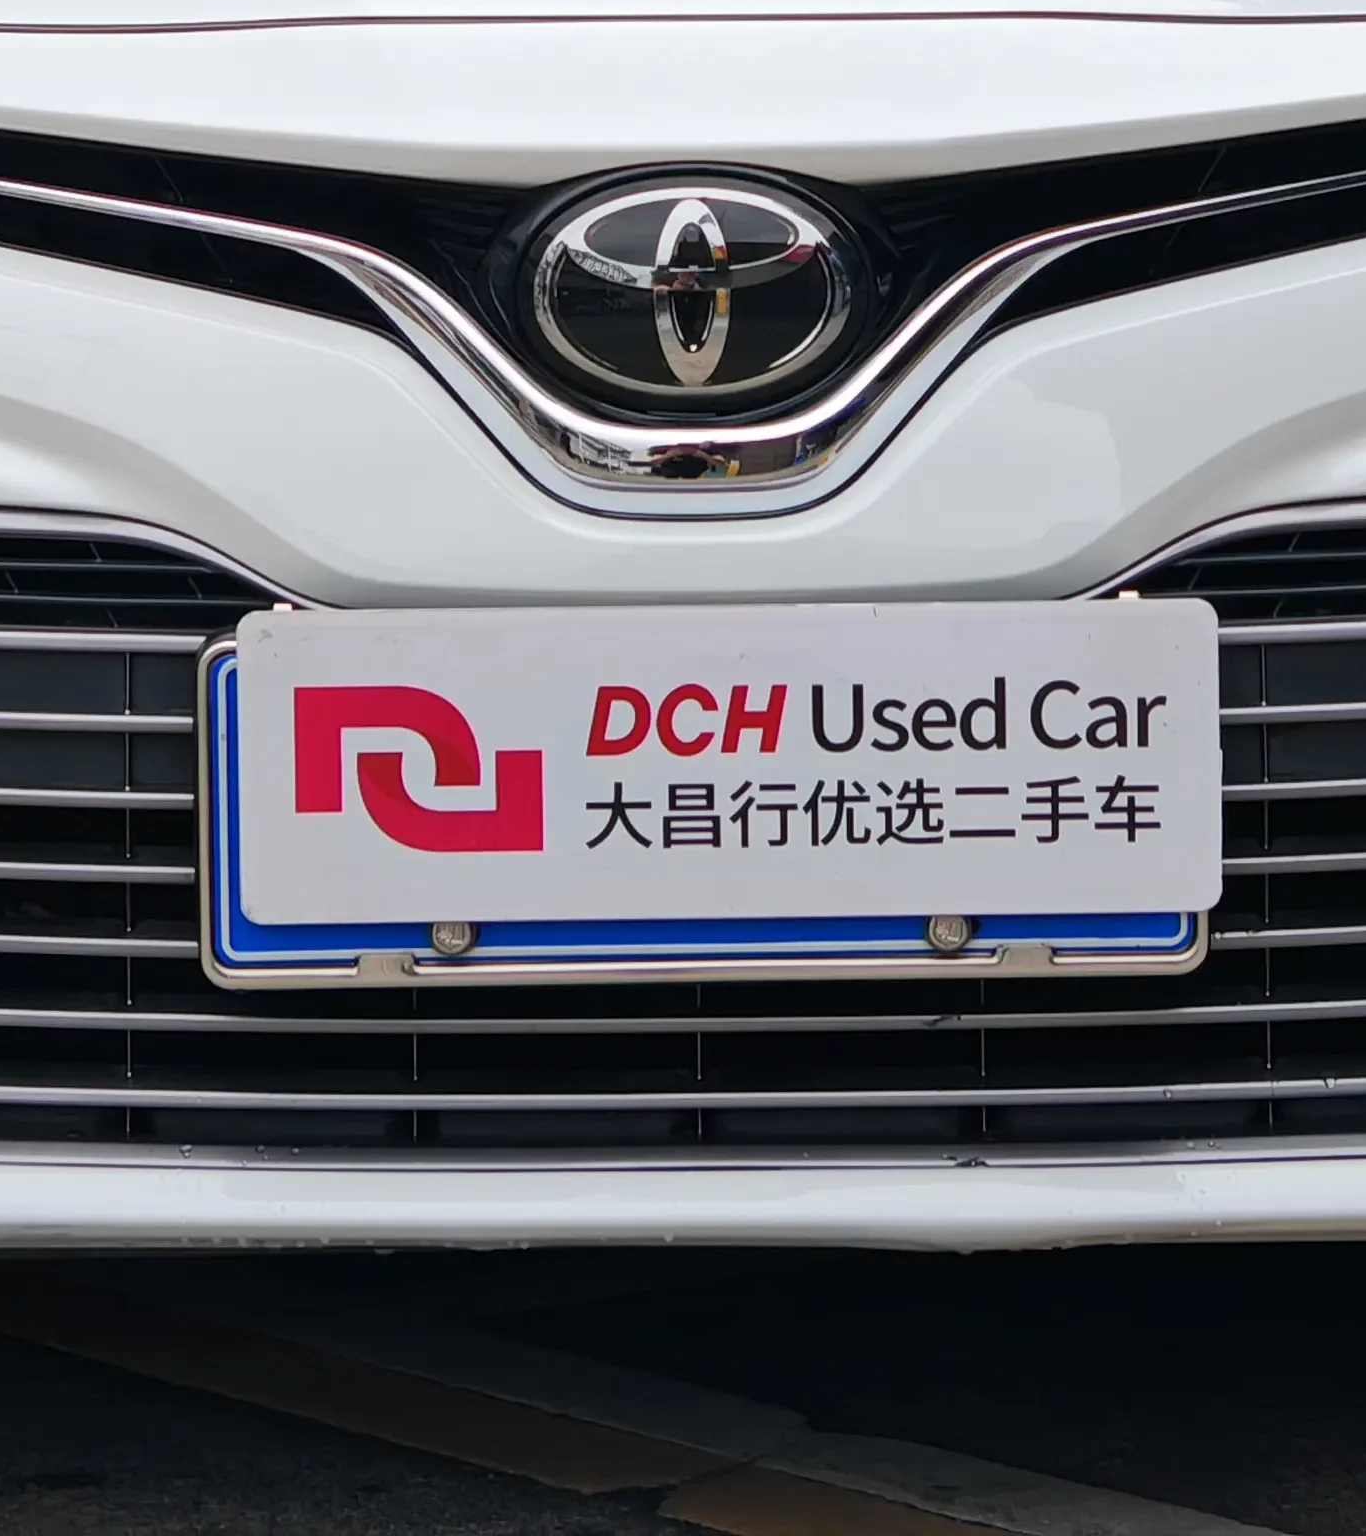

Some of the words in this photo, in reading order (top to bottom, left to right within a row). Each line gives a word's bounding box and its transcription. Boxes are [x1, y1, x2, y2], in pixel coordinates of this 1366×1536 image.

[586, 683, 787, 756] DCH
[812, 676, 1006, 752] Used
[1031, 679, 1167, 749] Car
[586, 775, 1161, 849] 大昌行优选二手车
